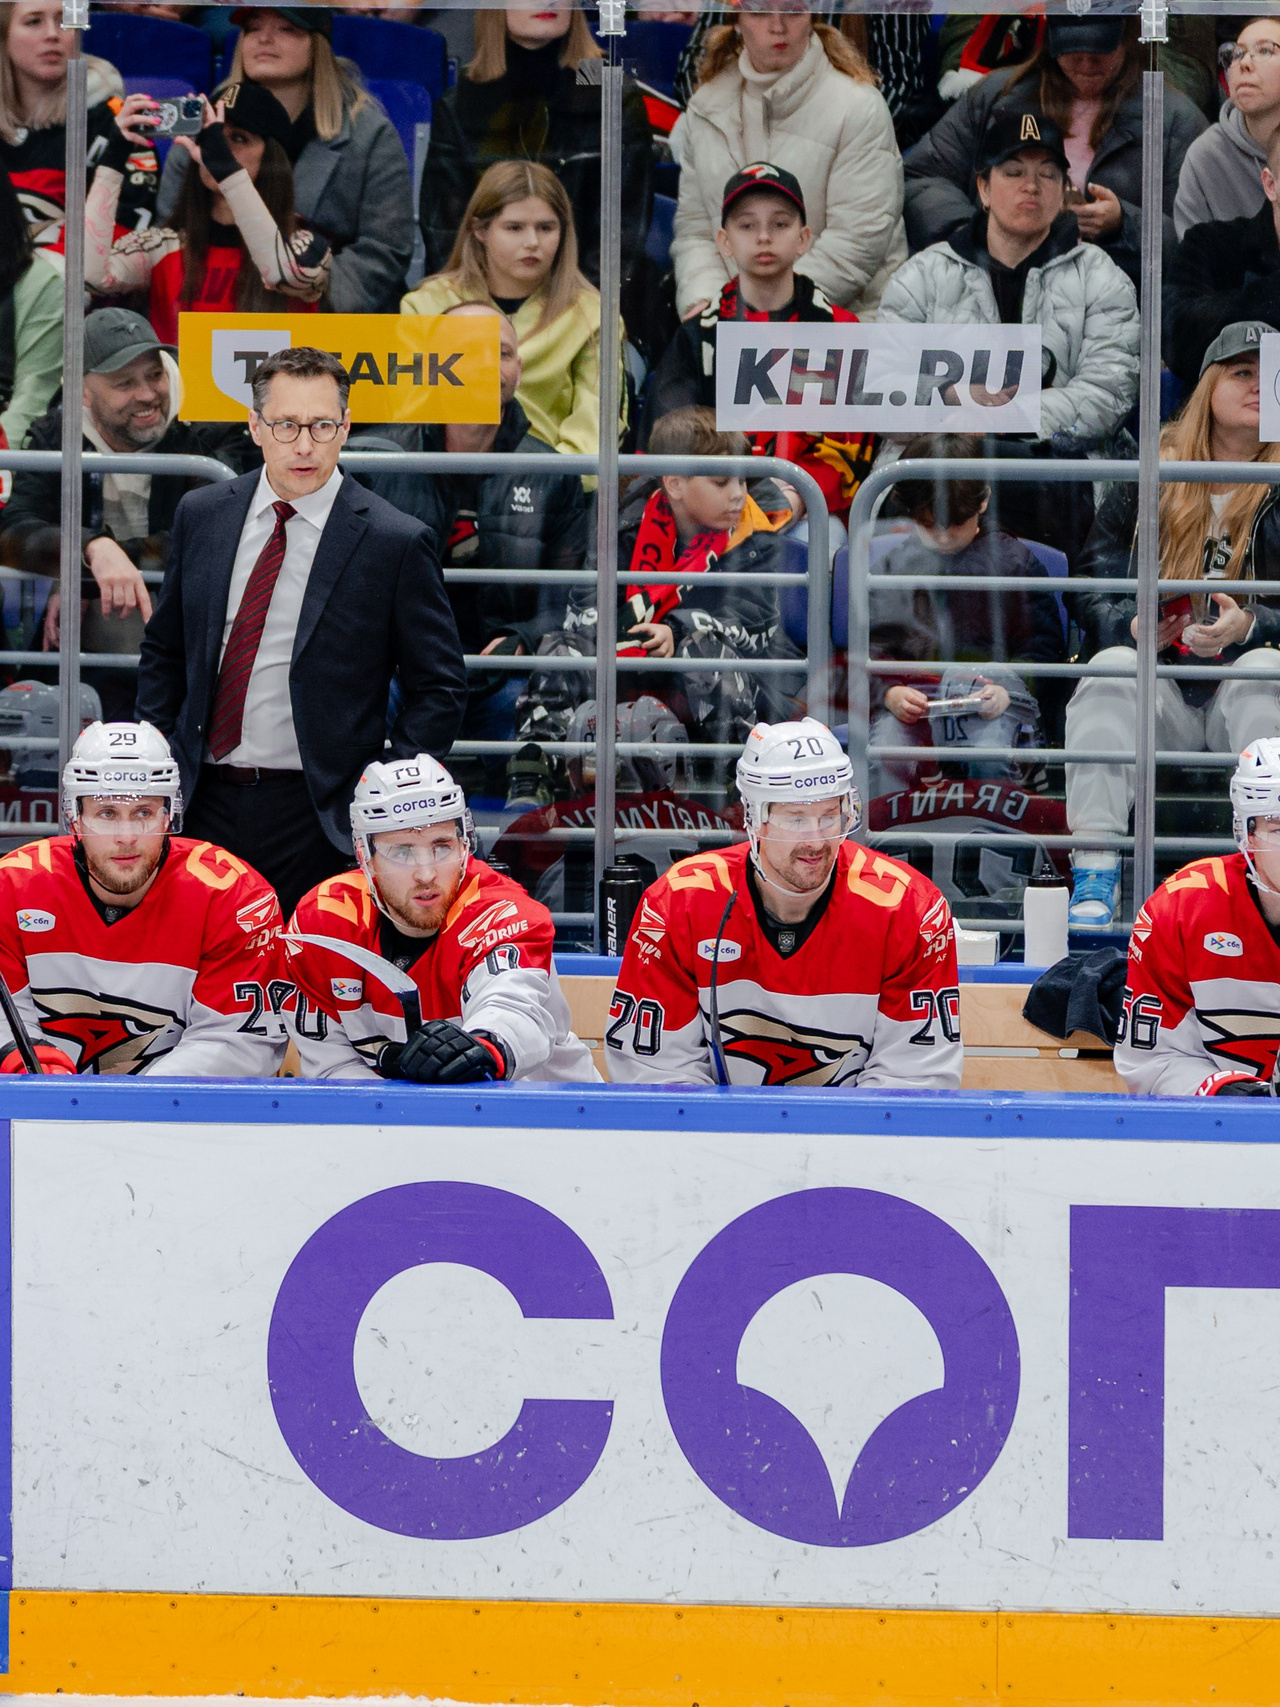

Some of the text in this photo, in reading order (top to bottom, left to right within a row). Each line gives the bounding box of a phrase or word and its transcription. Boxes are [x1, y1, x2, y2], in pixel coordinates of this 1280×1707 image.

[1021, 114, 1041, 141] A
[335, 351, 465, 386] АНК
[733, 347, 1024, 406] KHL.RU
[108, 732, 137, 746] 29
[787, 737, 824, 759] 20
[604, 988, 665, 1058] 20
[909, 986, 961, 1046] 20
